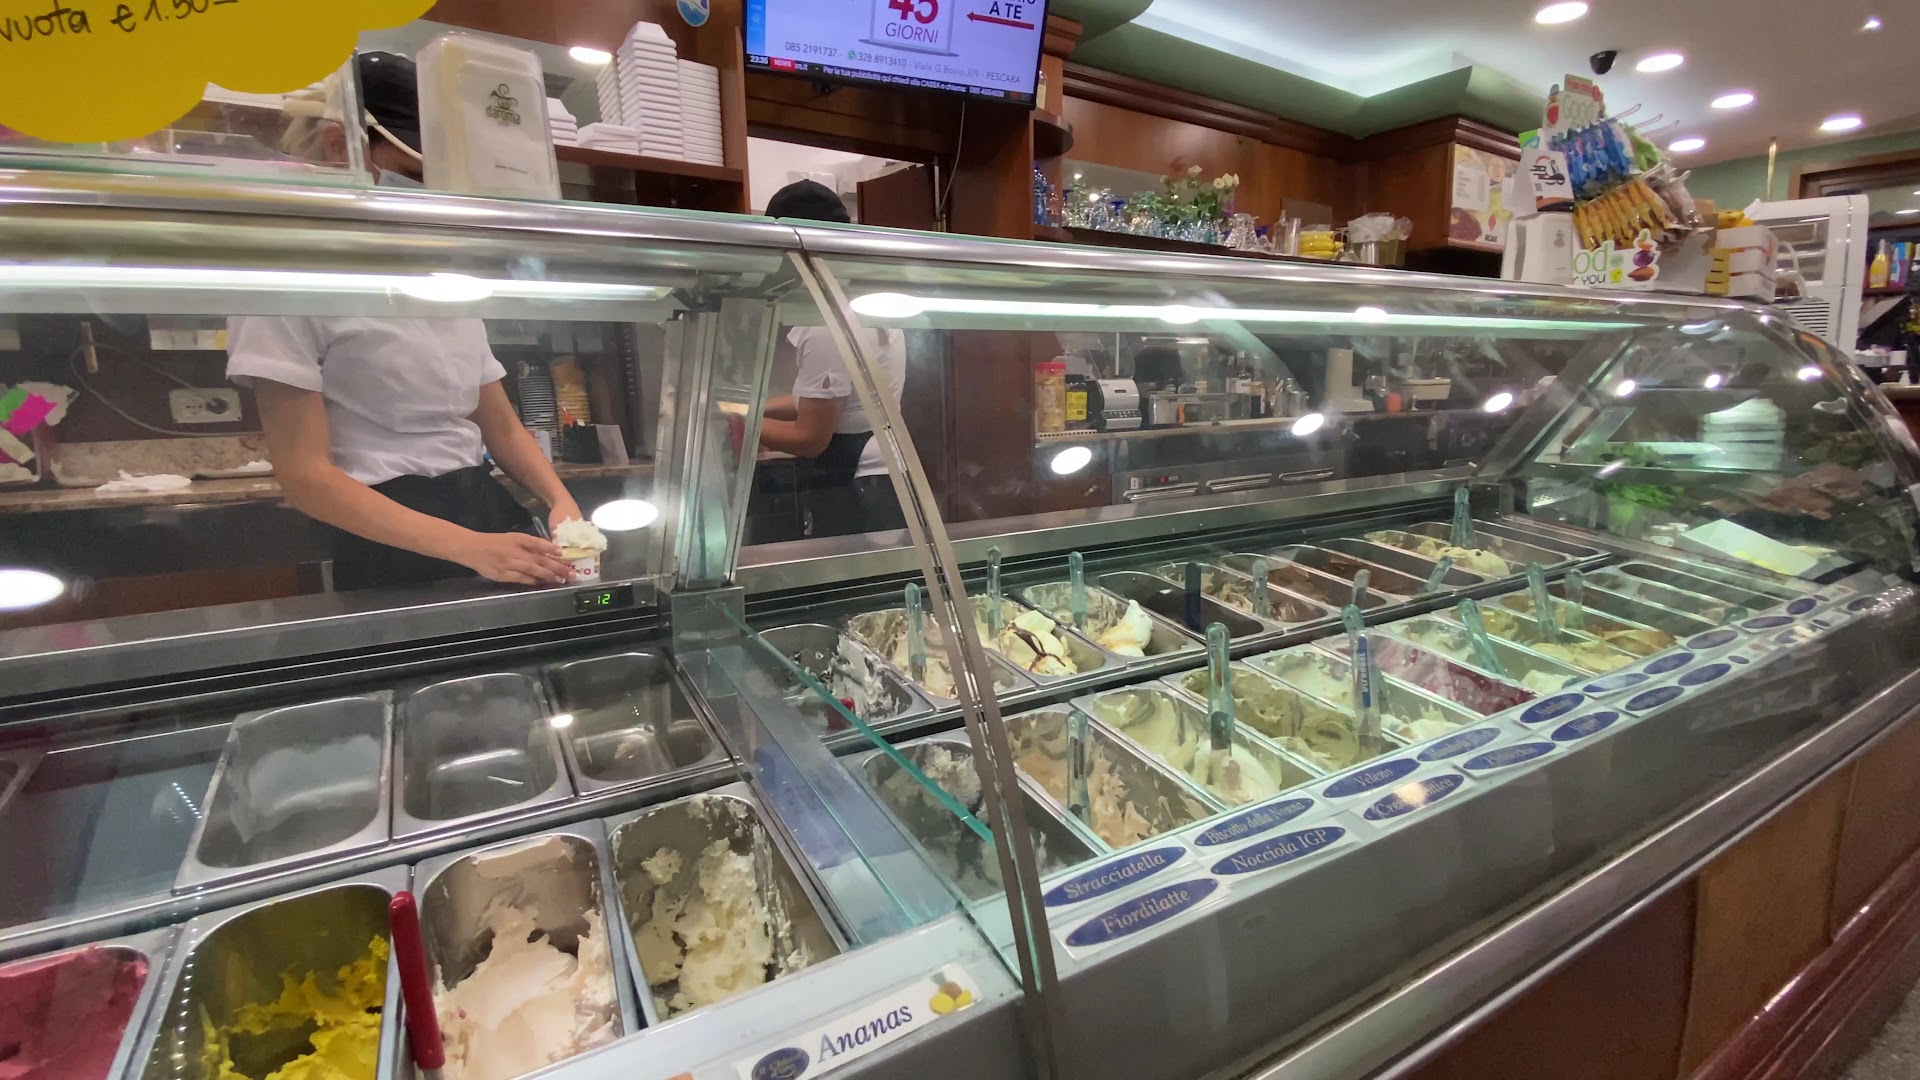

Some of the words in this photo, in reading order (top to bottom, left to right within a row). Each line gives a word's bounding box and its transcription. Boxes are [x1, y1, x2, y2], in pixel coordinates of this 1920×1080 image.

[989, 1, 1000, 16] A
[1005, 3, 1022, 19] TE
[885, 22, 939, 44] GIORNI
[784, 41, 801, 52] 085
[803, 44, 838, 57] 2191737
[986, 71, 1021, 84] PESCARA
[1205, 820, 1249, 845] Biscotto
[1248, 812, 1270, 829] della
[1269, 801, 1306, 820] Nonna
[1231, 841, 1299, 872] Nocciola
[1297, 828, 1328, 849] IGP
[1063, 852, 1166, 900] Stracciatella
[1102, 889, 1192, 934] Fiordilatte
[817, 1005, 913, 1064] Ananas
